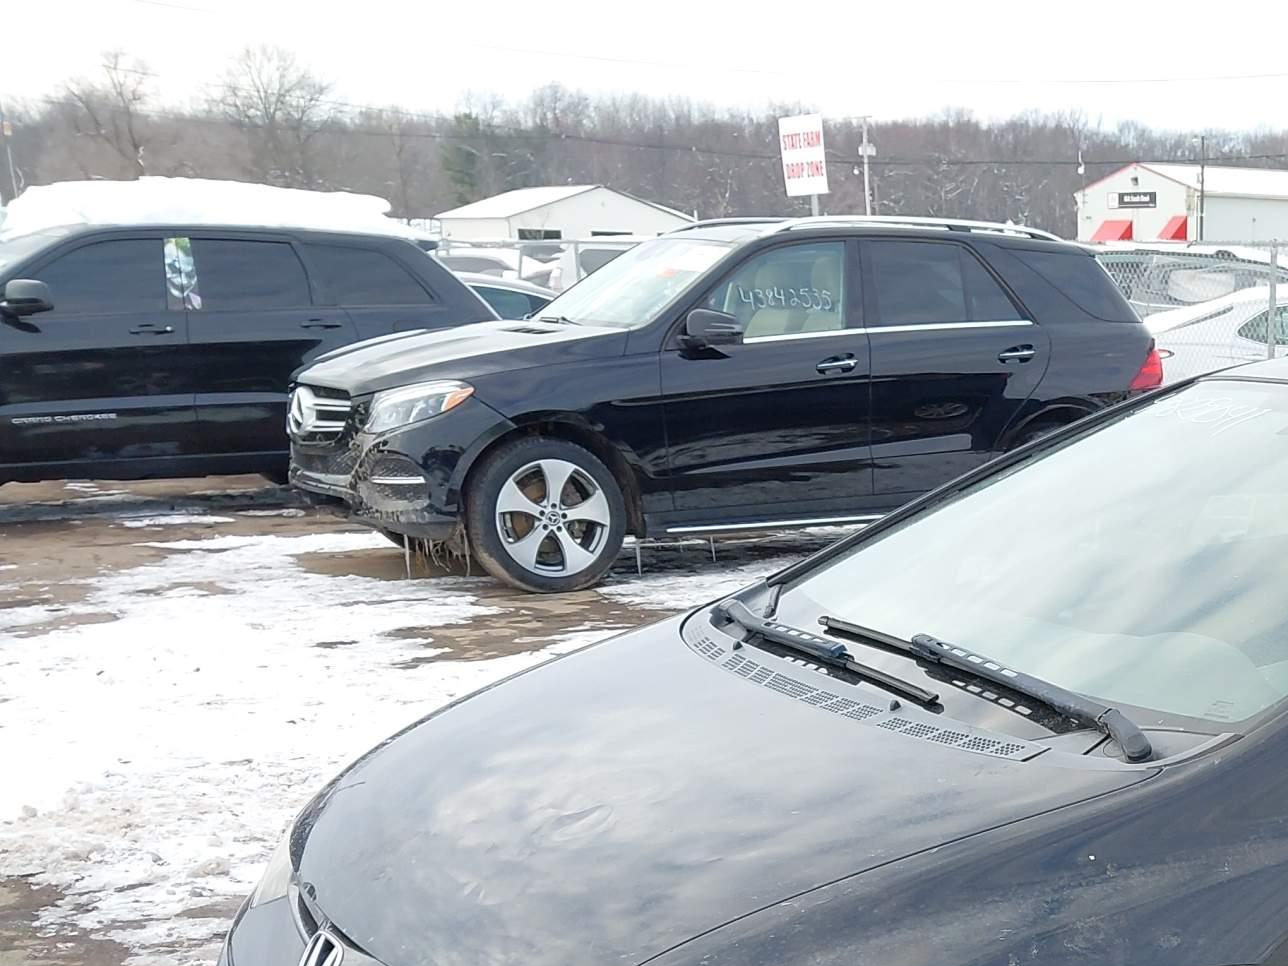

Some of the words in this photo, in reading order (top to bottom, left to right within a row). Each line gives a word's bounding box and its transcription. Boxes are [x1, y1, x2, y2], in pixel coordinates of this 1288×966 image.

[783, 132, 802, 151] STATE
[803, 130, 821, 149] FARM
[786, 162, 805, 179] DROP
[806, 160, 824, 177] ZONE
[738, 286, 833, 311] 43842535
